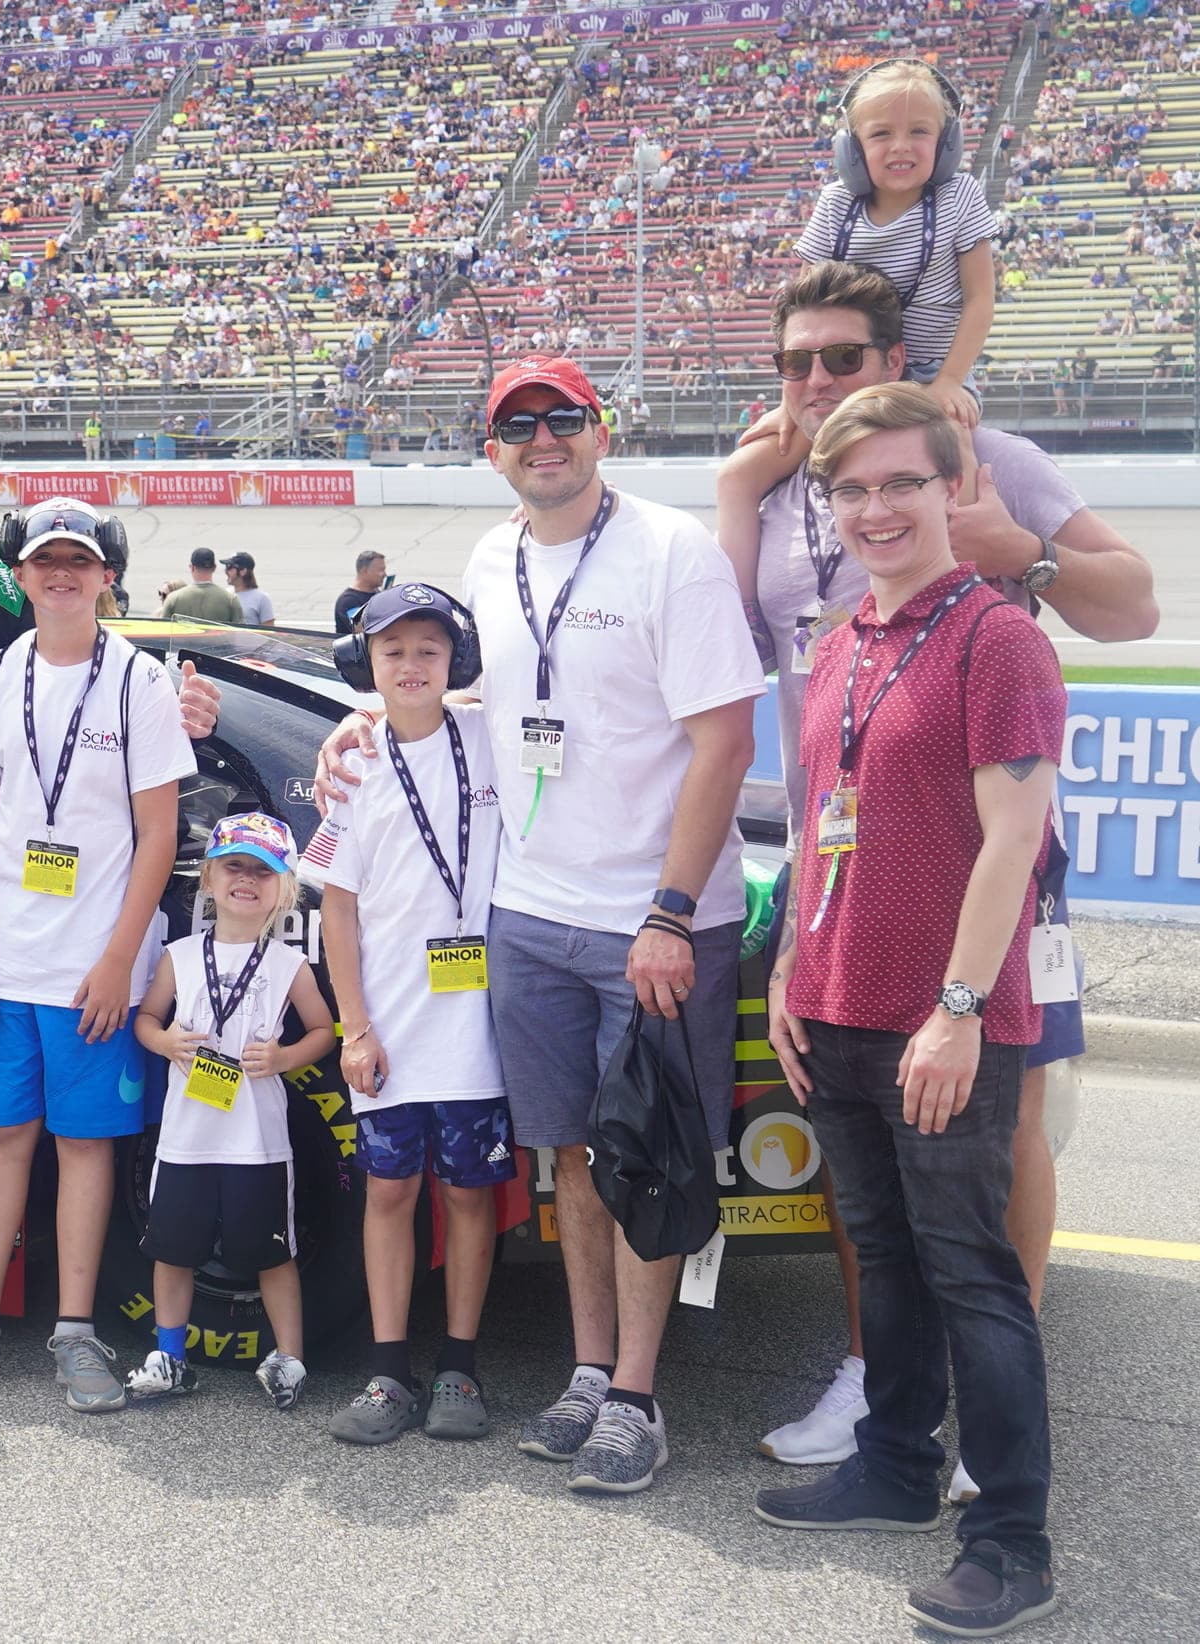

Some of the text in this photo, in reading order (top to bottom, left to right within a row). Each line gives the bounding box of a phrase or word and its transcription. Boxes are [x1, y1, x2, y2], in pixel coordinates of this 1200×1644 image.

[662, 9, 689, 26] ally
[741, 4, 770, 20] ally
[504, 21, 531, 37] ally
[580, 15, 607, 31] ally
[358, 31, 384, 47] ally
[79, 51, 103, 67] ally
[146, 47, 170, 61] ally
[565, 606, 625, 630] SciAps
[564, 623, 601, 631] RACING
[80, 728, 127, 751] SciA
[543, 731, 561, 745] VIP
[80, 743, 118, 753] RACING
[1058, 714, 1200, 786] CHI
[289, 781, 315, 806] Ag
[468, 784, 499, 801] SciA
[28, 852, 74, 869] MINOR
[431, 949, 482, 963] MINOR
[195, 1059, 240, 1084] MINOR
[719, 1203, 829, 1225] NTRACTOR
